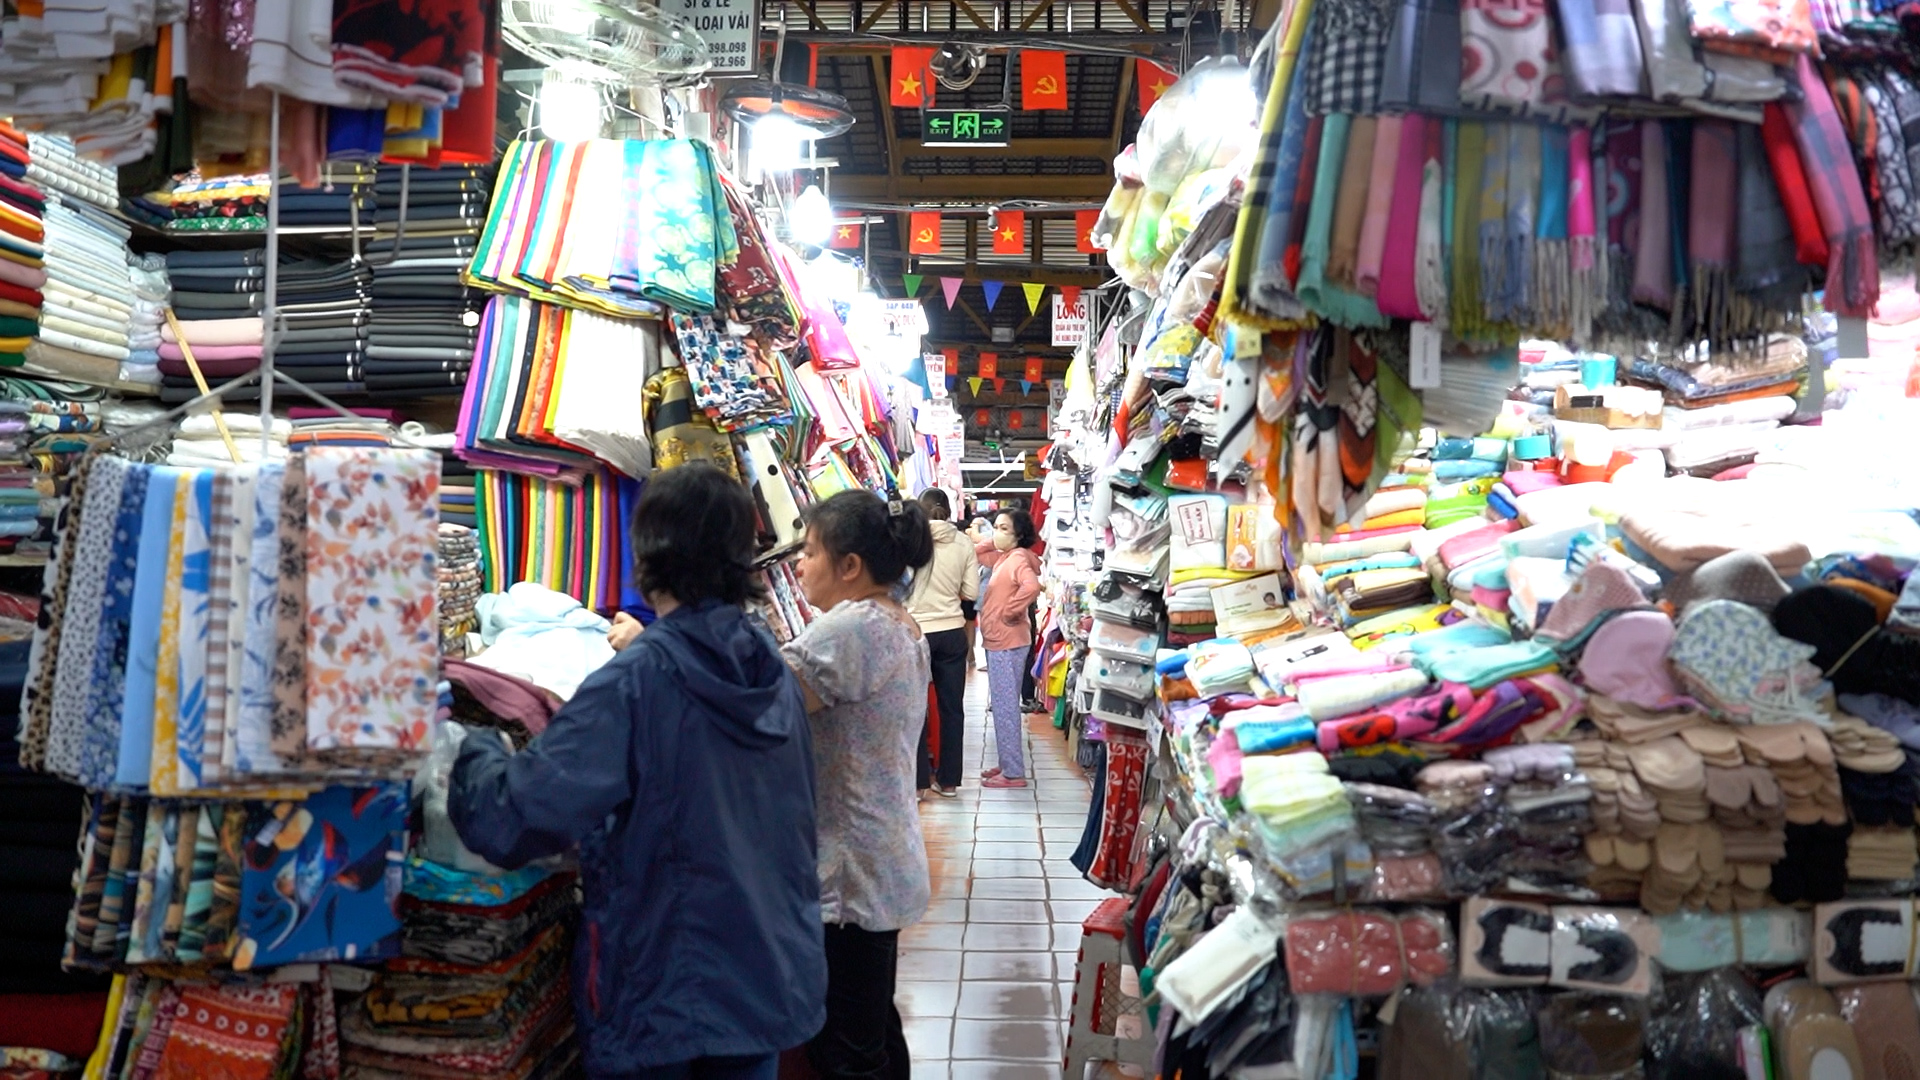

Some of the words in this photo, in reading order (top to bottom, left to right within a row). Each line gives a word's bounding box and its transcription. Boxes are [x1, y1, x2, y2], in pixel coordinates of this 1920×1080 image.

[695, 15, 724, 33] LOẠI
[728, 11, 750, 29] VẢI
[708, 42, 747, 53] 398.098
[713, 56, 746, 67] 32.966
[1056, 304, 1085, 319] LONG
